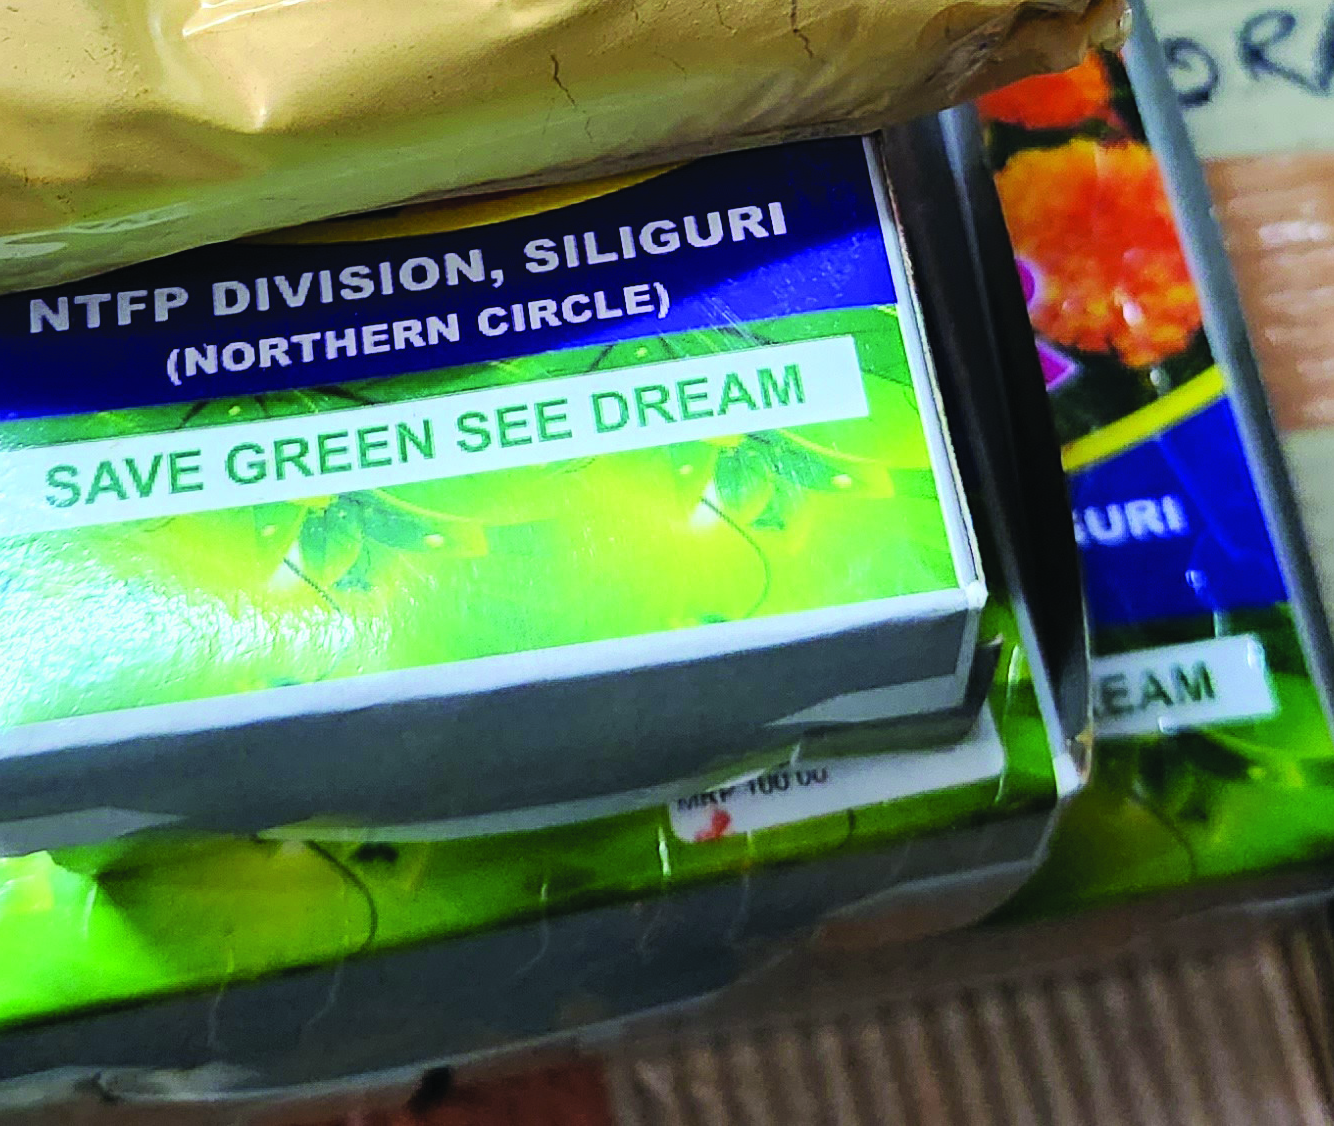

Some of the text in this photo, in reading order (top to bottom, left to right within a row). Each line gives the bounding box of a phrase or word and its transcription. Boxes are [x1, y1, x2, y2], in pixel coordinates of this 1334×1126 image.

[29, 201, 788, 334] NTFP DIVISION, SILIGURI
[166, 281, 671, 386] (NORTHERN CIRCLE)
[44, 362, 807, 509] SAVE GREEN SEE DREAM
[1072, 494, 1188, 547] URI
[1092, 659, 1216, 717] EAM
